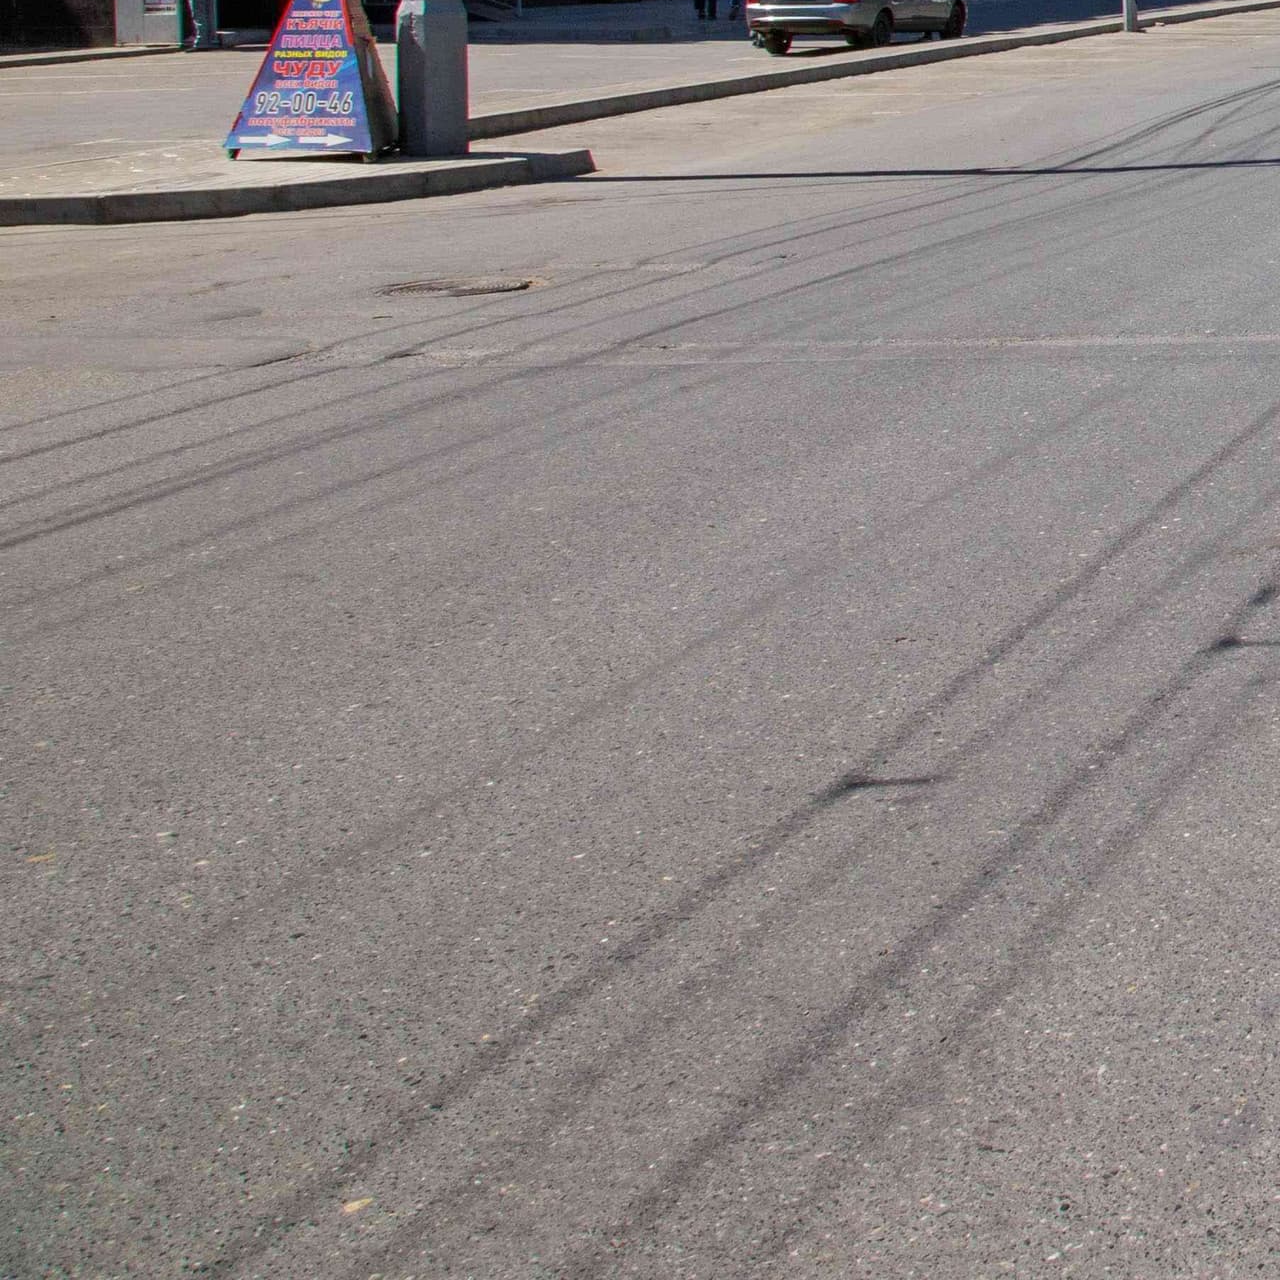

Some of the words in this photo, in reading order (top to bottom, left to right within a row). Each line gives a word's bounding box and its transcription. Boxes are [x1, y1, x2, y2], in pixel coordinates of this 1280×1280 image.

[281, 34, 343, 49] ПИЦЦА
[274, 50, 313, 58] РАЗНЫХ
[273, 60, 342, 78] ЧУДУ
[255, 91, 354, 115] 92-00-46
